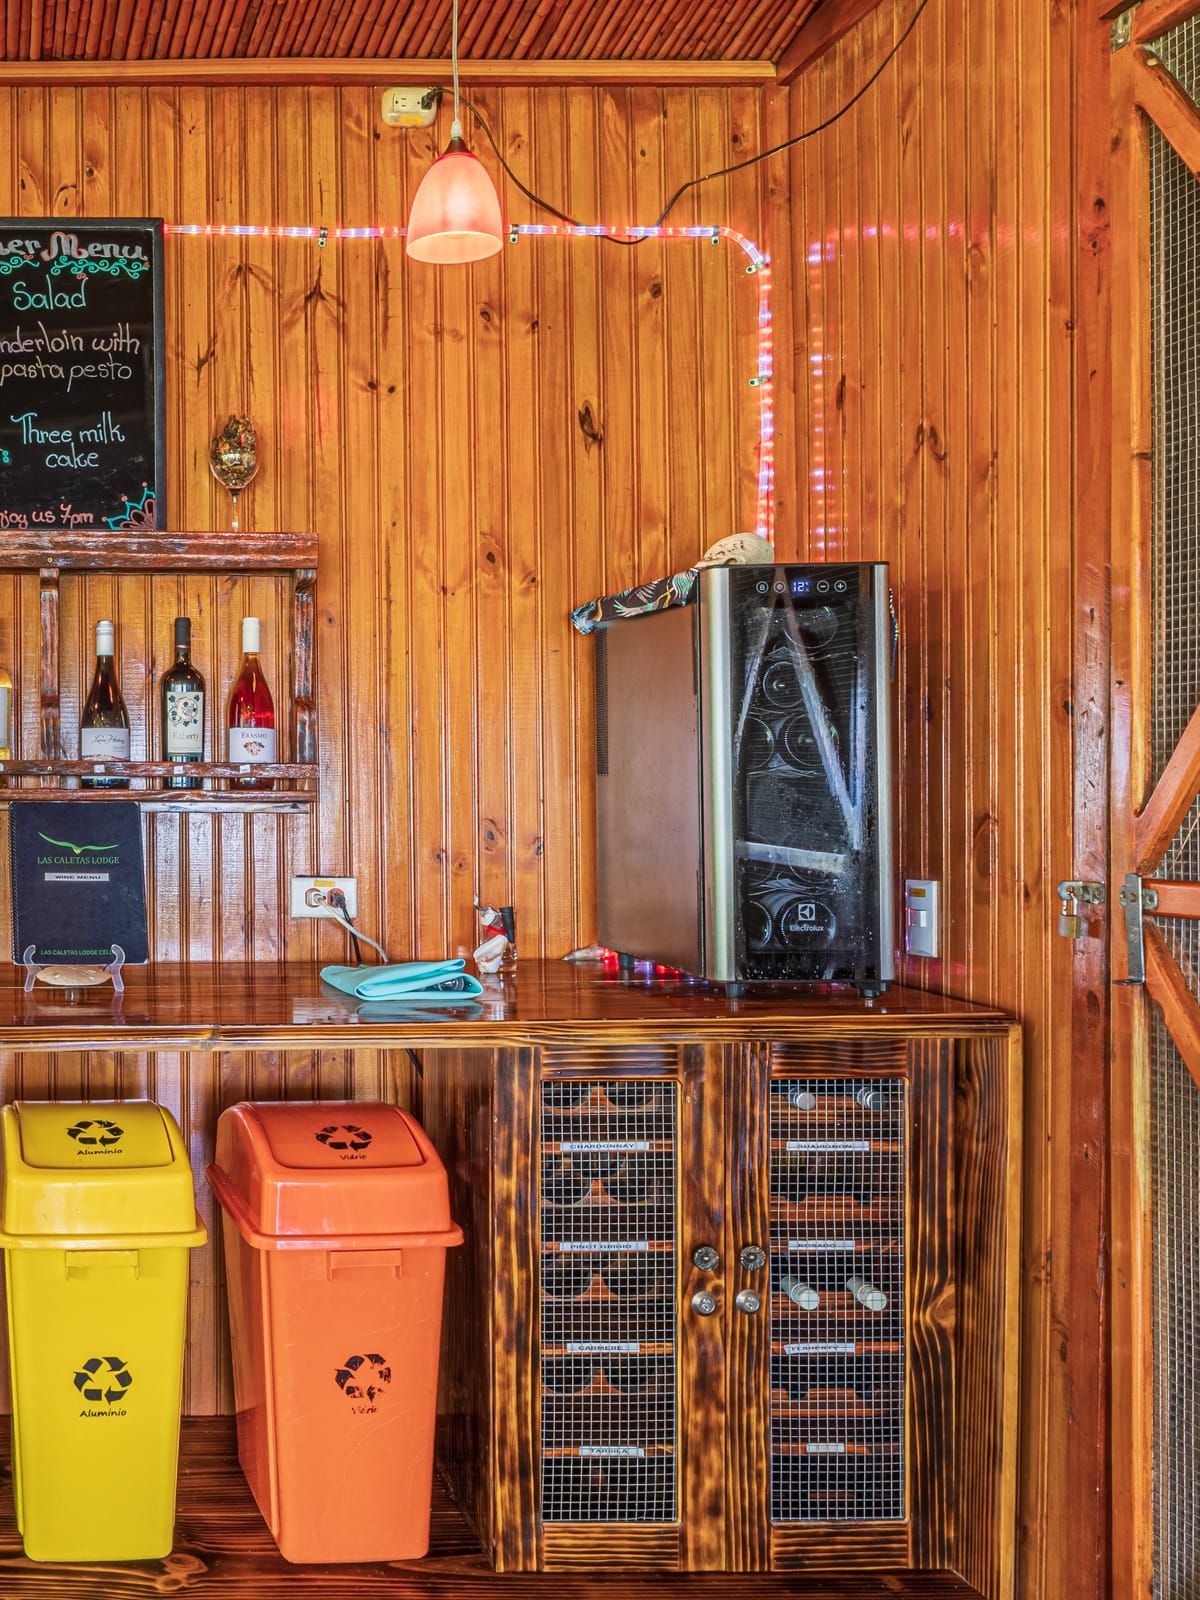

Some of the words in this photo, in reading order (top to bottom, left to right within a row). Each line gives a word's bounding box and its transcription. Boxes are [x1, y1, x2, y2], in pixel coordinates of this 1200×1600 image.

[41, 231, 148, 262] Menu
[12, 275, 88, 311] Salad
[92, 322, 140, 355] with
[0, 355, 64, 387] pasta
[67, 353, 132, 392] pesto
[10, 412, 73, 444] Three
[79, 411, 125, 444] milk
[45, 442, 100, 469] cake
[32, 509, 56, 524] us
[60, 503, 94, 529] 7pm
[37, 856, 53, 865] LAS
[54, 856, 90, 865] CALETAS
[91, 856, 120, 865] LODGE
[789, 923, 825, 932] Electrolux
[79, 1407, 128, 1418] Aluminio
